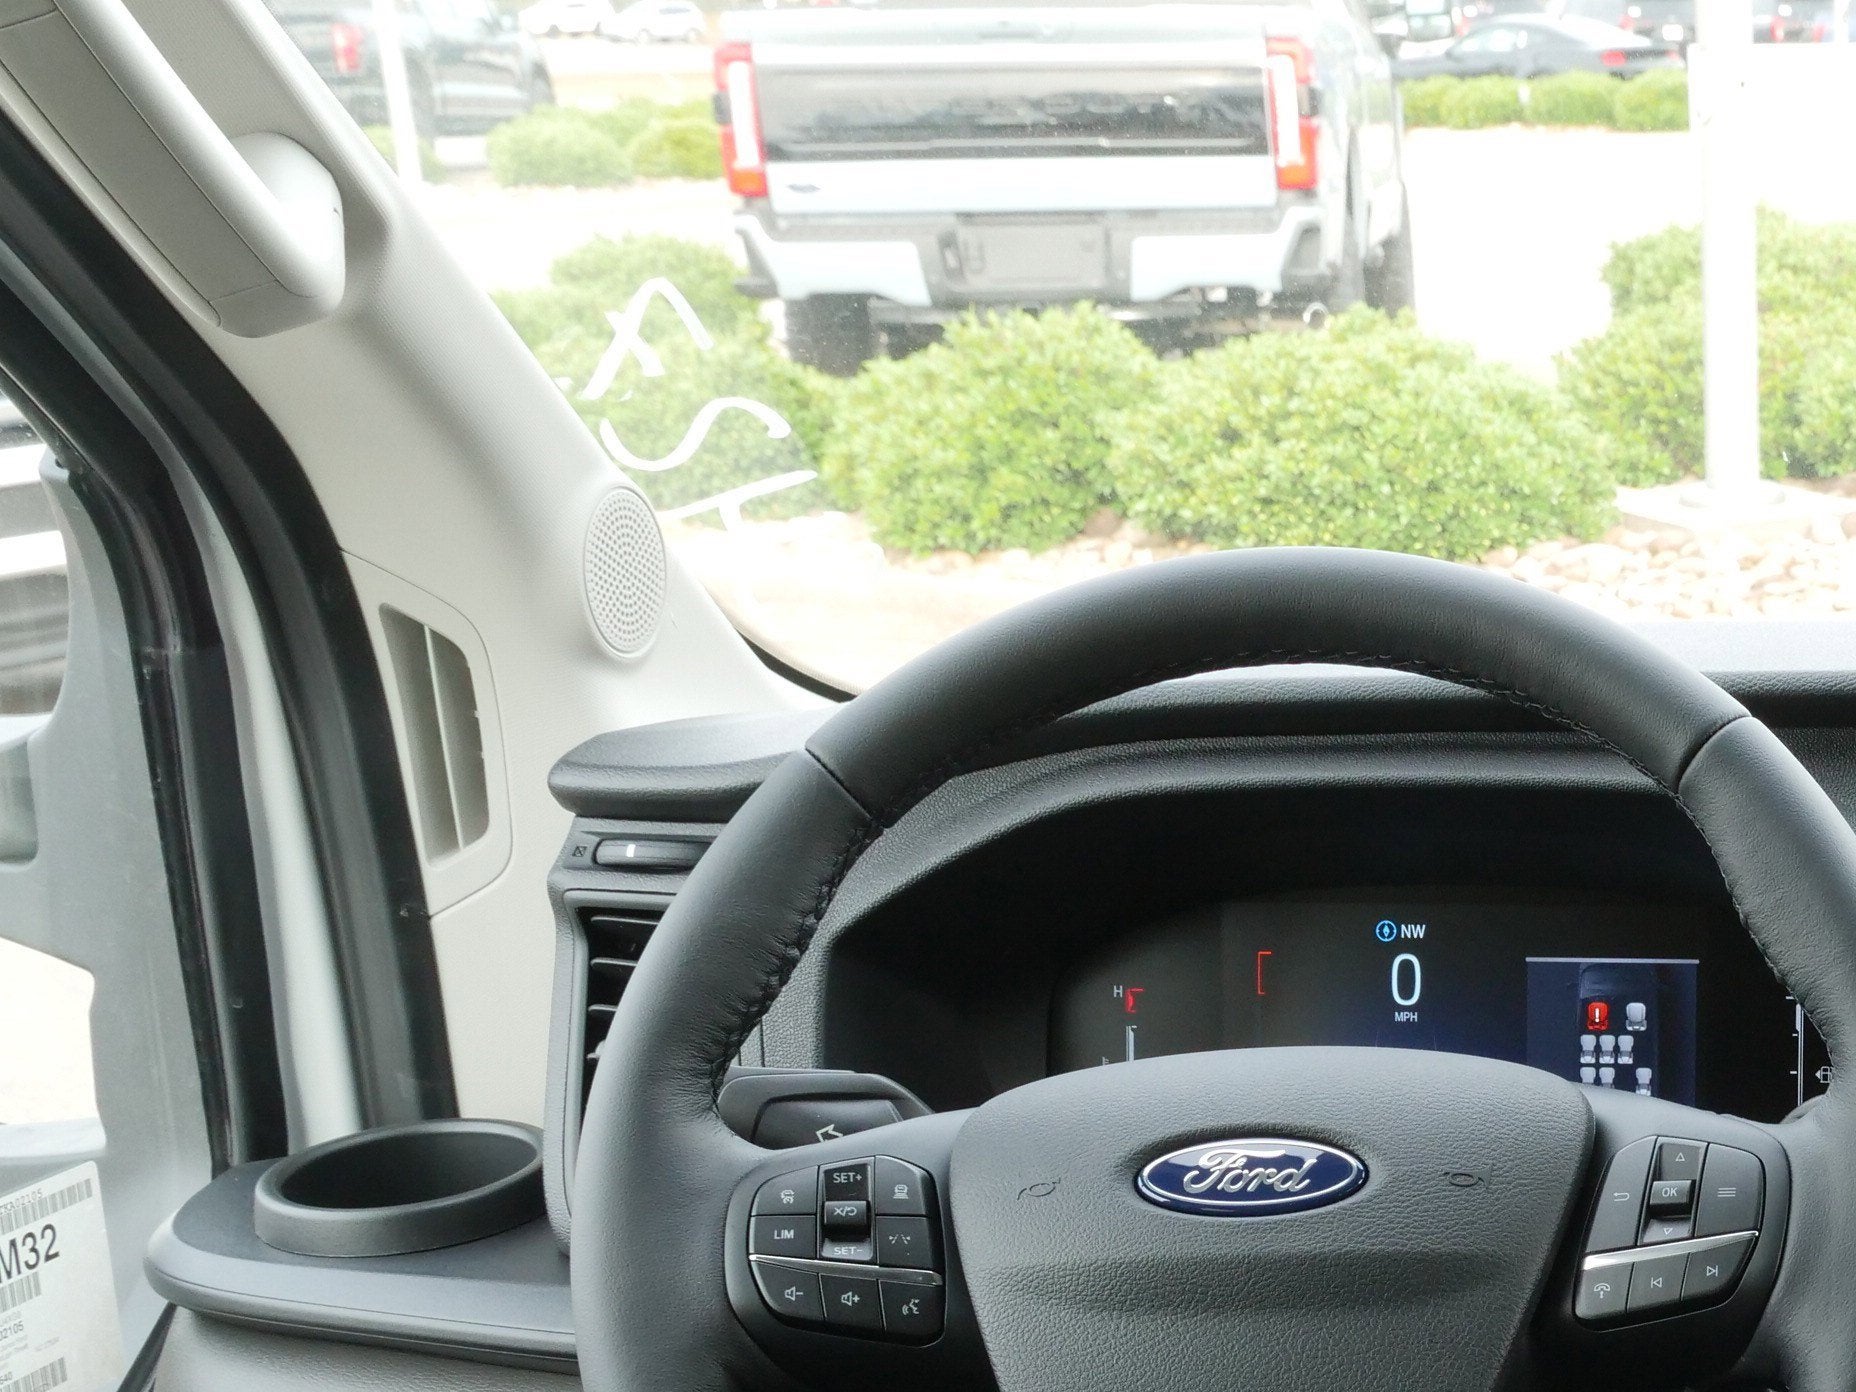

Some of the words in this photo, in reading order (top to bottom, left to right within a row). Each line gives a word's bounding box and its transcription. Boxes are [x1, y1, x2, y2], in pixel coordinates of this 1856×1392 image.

[1400, 923, 1426, 939] NW
[1391, 952, 1421, 1006] 0
[1113, 985, 1123, 998] H
[1394, 1011, 1418, 1022] MPH
[1183, 1148, 1312, 1194] Ford
[1661, 1187, 1678, 1197] OK
[773, 1229, 795, 1240] LIM
